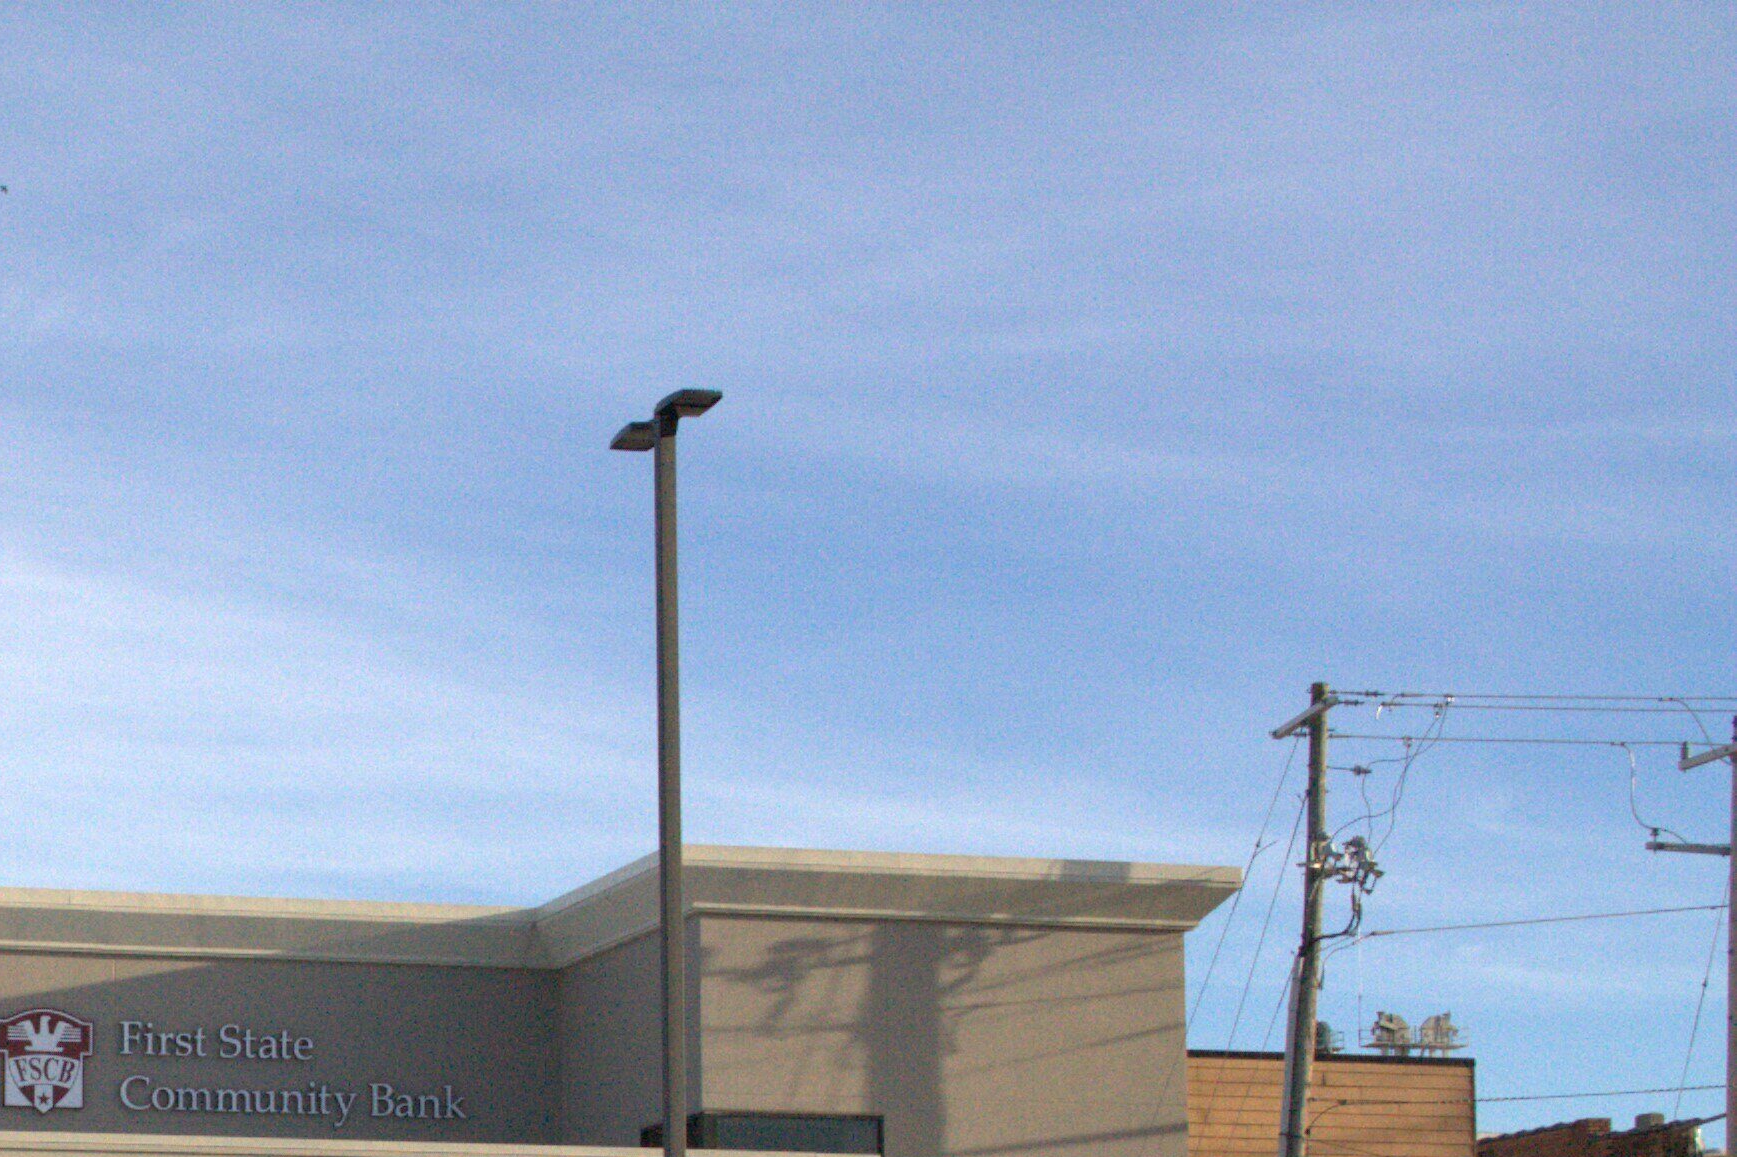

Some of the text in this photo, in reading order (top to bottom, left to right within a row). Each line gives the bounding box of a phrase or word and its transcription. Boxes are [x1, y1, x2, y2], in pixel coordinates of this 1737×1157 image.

[119, 1020, 314, 1060] First State
[14, 1057, 75, 1083] FSCB
[120, 1075, 466, 1127] Community Bank
